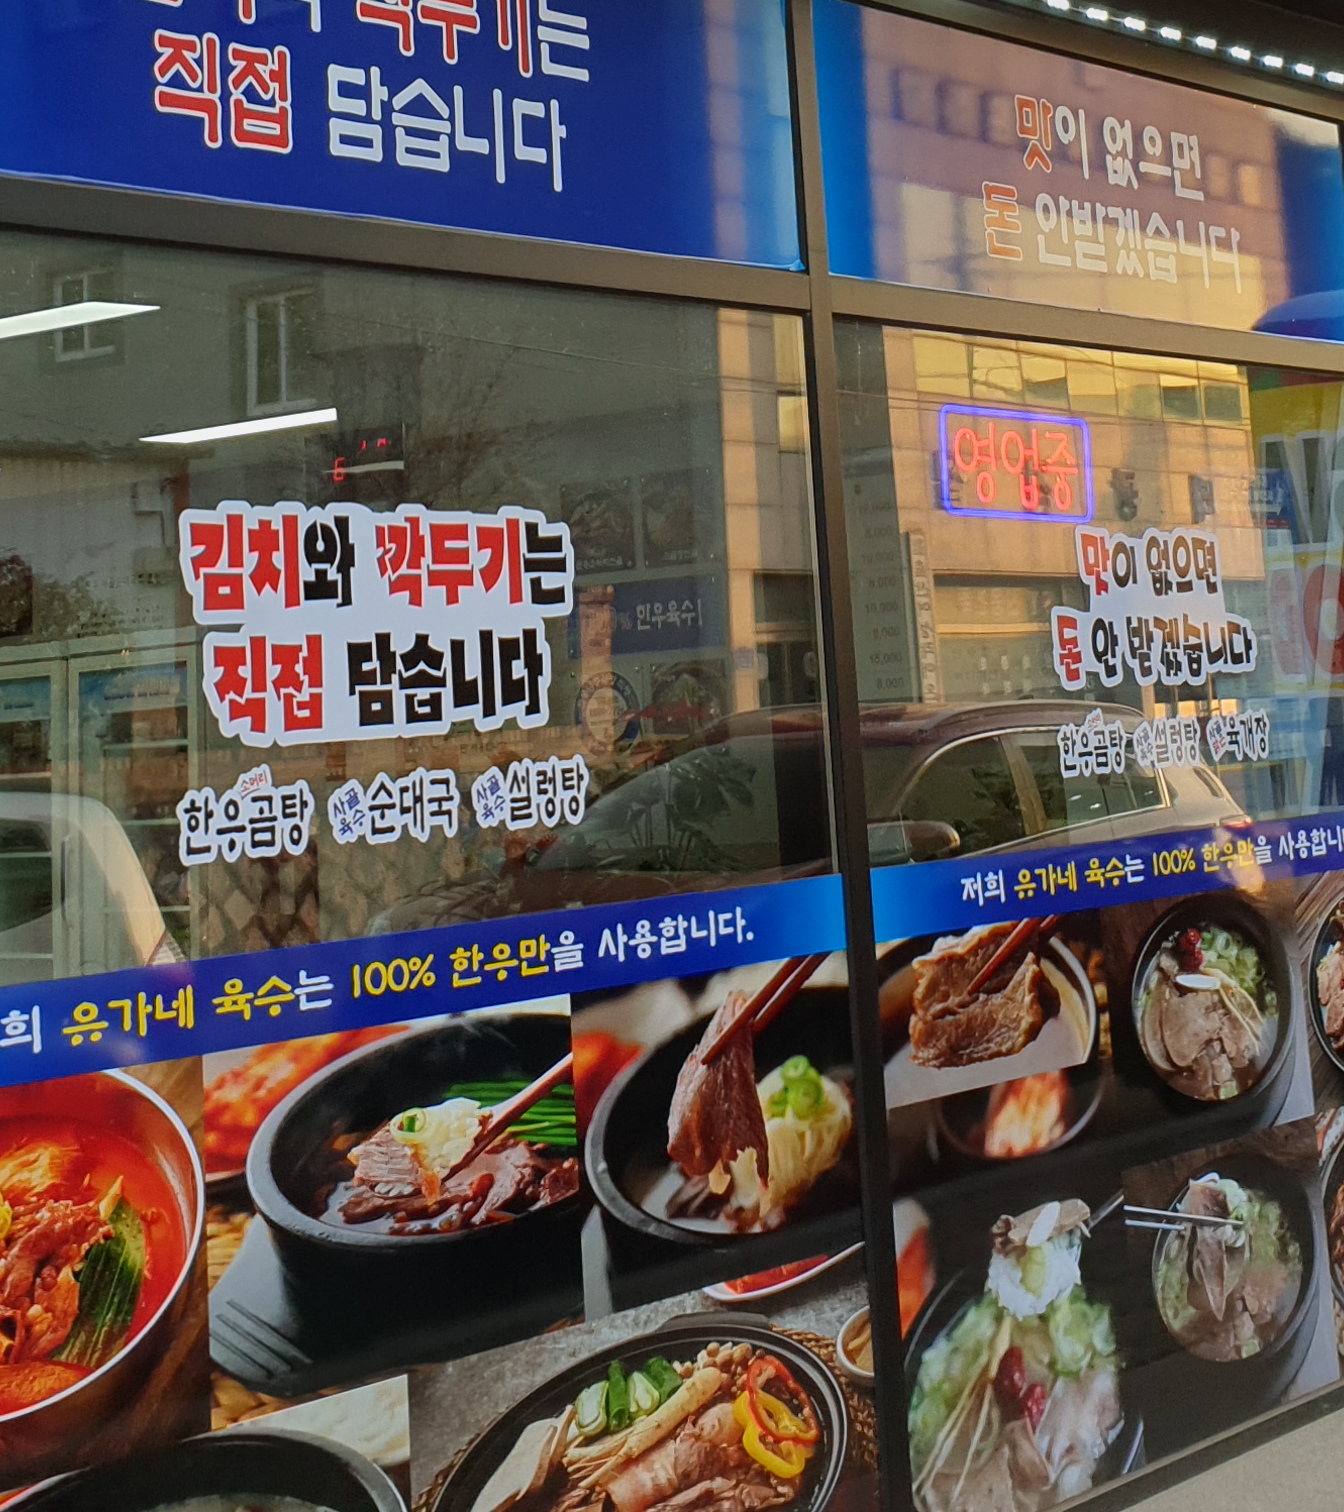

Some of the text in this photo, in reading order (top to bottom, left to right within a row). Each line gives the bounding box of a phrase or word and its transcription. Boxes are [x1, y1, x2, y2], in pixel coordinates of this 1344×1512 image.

[154, 29, 567, 193] 직접 담습니다
[1014, 92, 1205, 202] 맛이 없으면
[982, 180, 1023, 263] 돈
[953, 421, 1080, 512] 영업중
[189, 513, 567, 611] 김치와 깍두기는
[1080, 533, 1219, 597] 맛이 없으면
[213, 634, 323, 734] 직접
[346, 628, 544, 728] 담습니다
[1056, 614, 1083, 682] 돈
[1060, 726, 1125, 772] 한우곰탕
[1155, 722, 1198, 764] 설렁탕
[1226, 714, 1267, 756] 육개장
[183, 790, 309, 857] 한우곰탕
[368, 774, 455, 838] 순대국
[509, 764, 585, 822] 설렁탕
[960, 868, 1007, 906] 저희
[1013, 860, 1078, 900] 유가네
[1084, 854, 1146, 889] 육수는
[1152, 847, 1197, 878] 100%
[1201, 837, 1273, 874] 한우만을
[60, 985, 196, 1048] 유가네
[210, 968, 334, 1021] 육수는
[350, 953, 437, 1000] 100%
[447, 931, 584, 992] 한우만을
[597, 907, 756, 965] 사용합니다.
